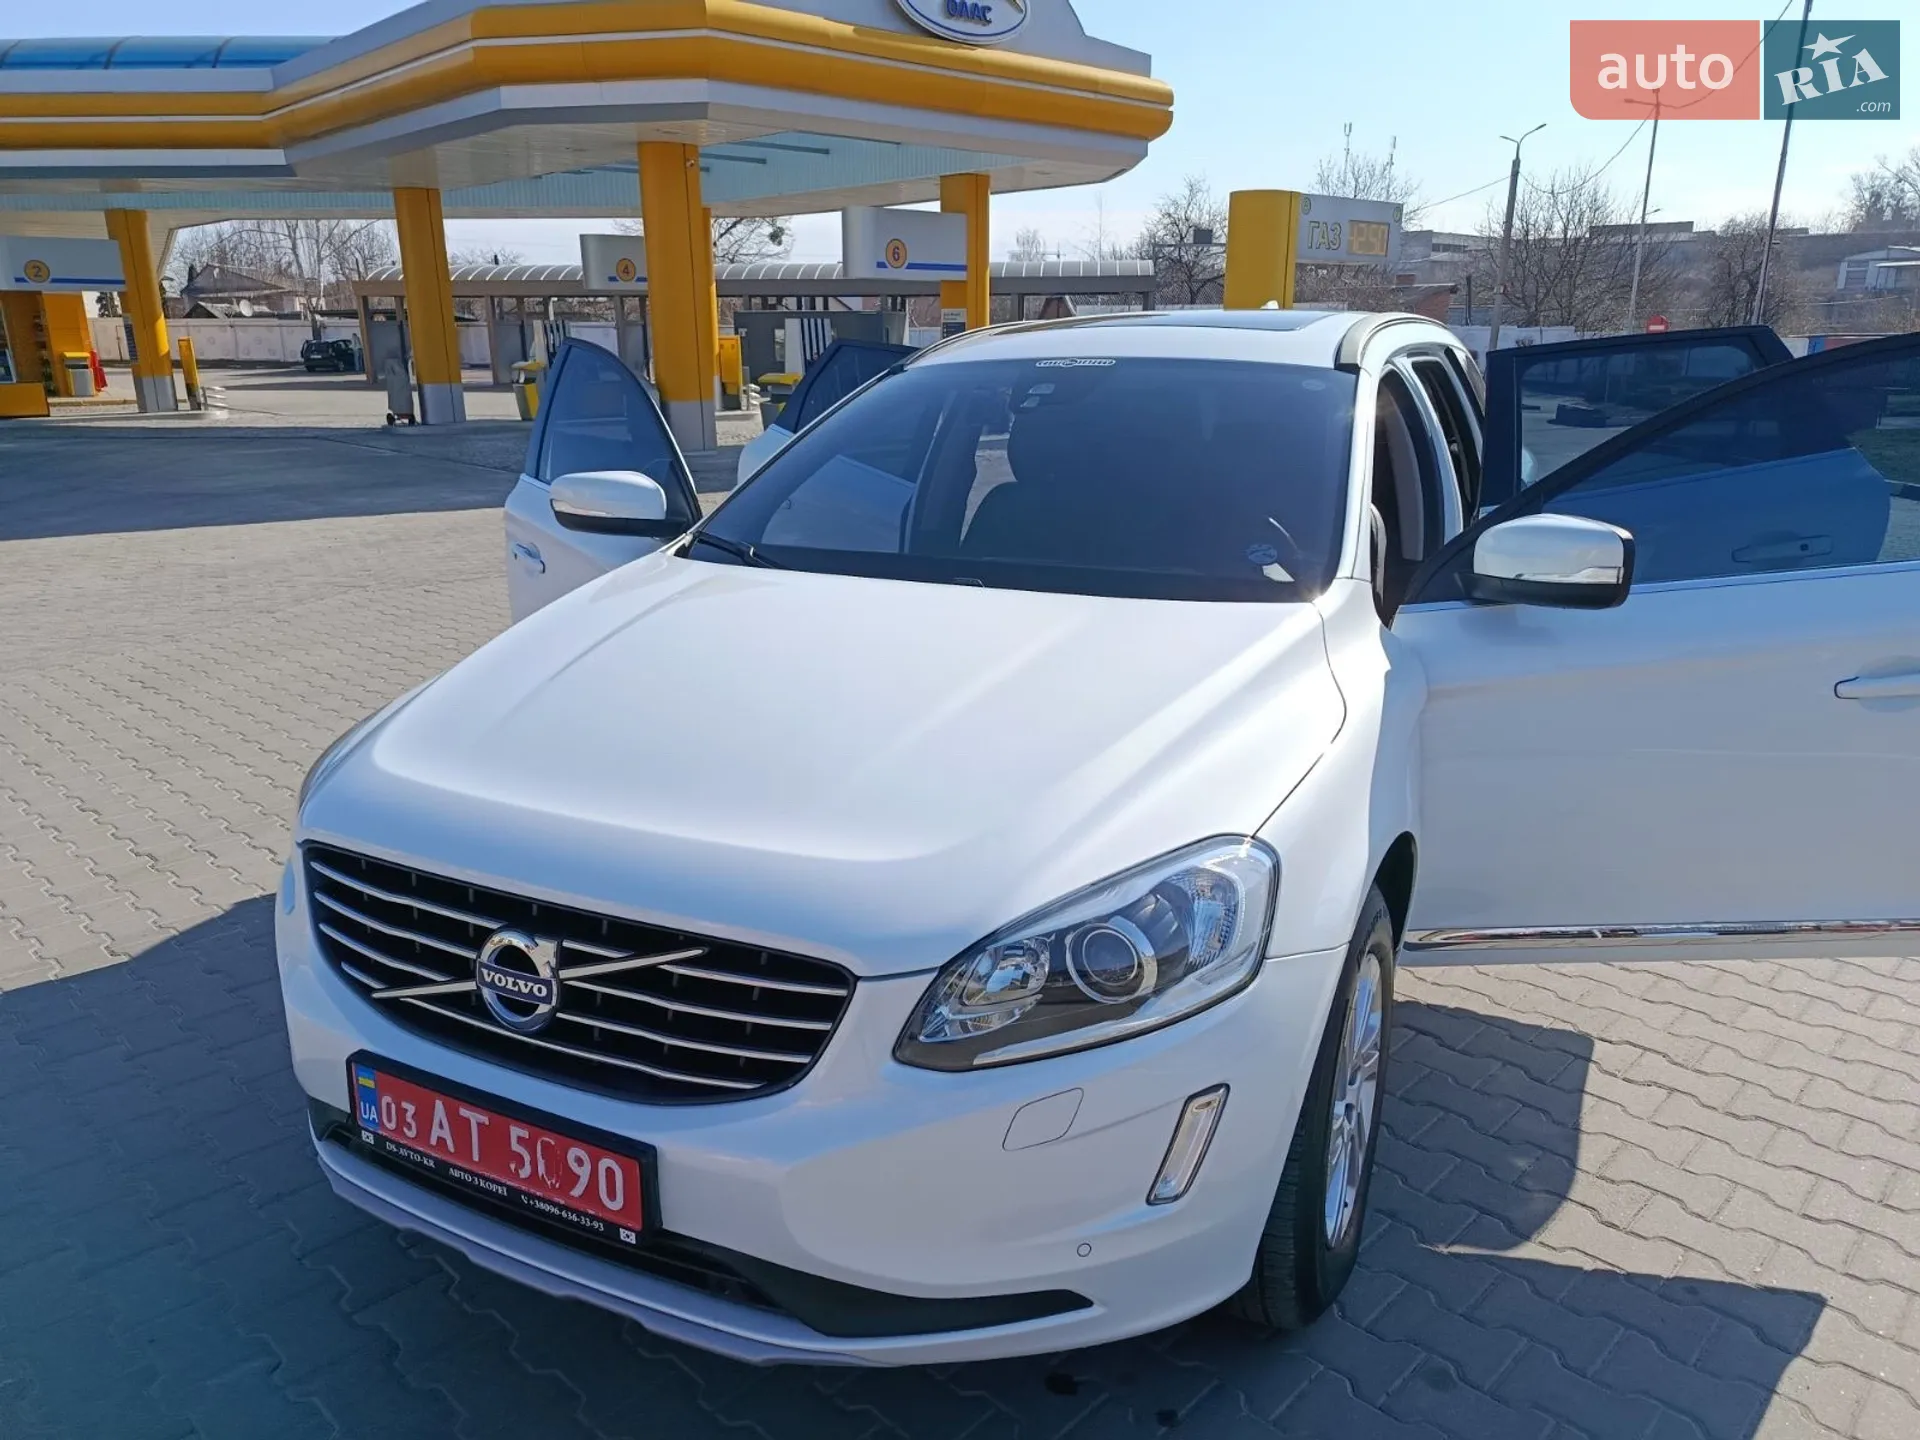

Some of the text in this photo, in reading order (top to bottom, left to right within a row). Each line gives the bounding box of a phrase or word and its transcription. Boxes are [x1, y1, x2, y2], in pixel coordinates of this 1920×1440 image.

[1307, 220, 1342, 250] ГАЗ
[892, 246, 900, 261] 6
[32, 265, 42, 277] 2
[622, 263, 630, 277] 4
[481, 968, 547, 997] VOLVO
[360, 1101, 378, 1123] UA
[381, 1095, 417, 1138] 03
[430, 1099, 490, 1161] AT
